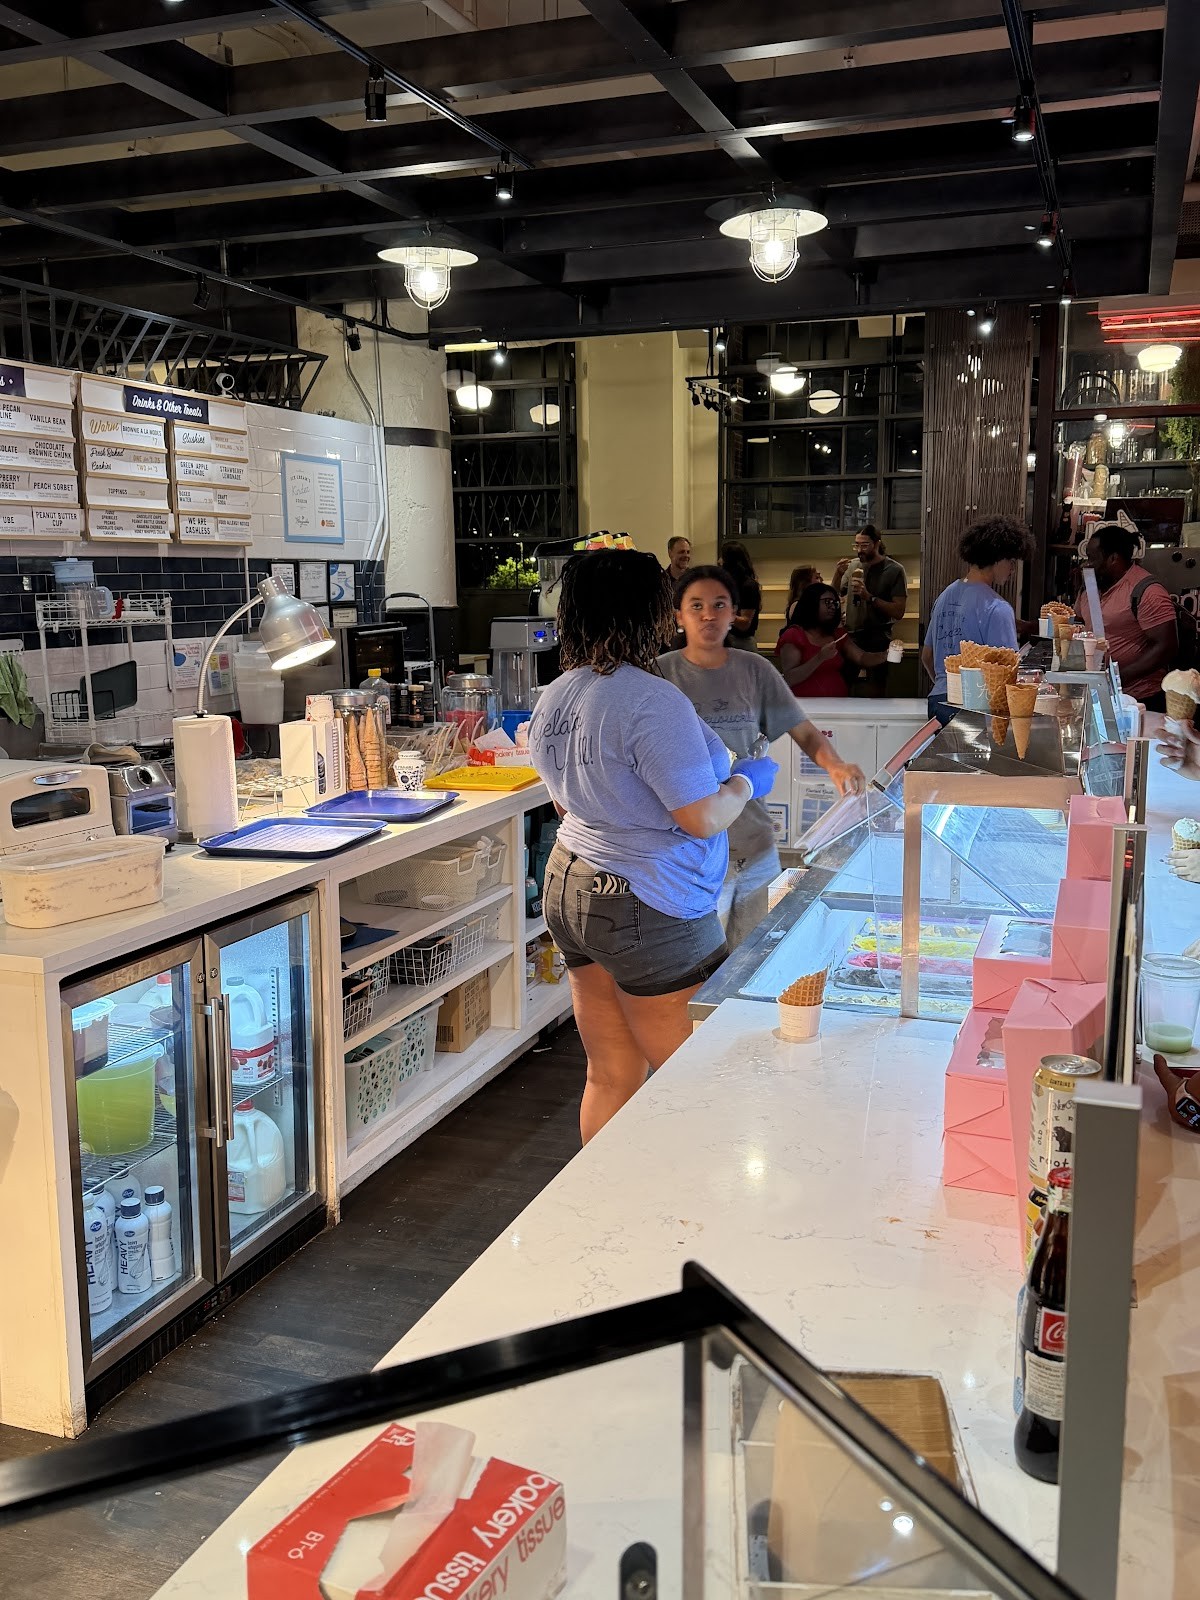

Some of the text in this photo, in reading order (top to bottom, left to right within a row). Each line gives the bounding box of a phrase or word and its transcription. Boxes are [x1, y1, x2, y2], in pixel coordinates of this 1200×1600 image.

[3, 403, 21, 413] PECAN
[132, 394, 203, 418] Drinks & Other Treats
[0, 411, 12, 420] LINE
[30, 414, 67, 426] VANILLA BEAN
[89, 419, 120, 434] Warm
[122, 425, 140, 434] BROWNIE
[0, 445, 18, 454] OLATE
[34, 441, 65, 451] CHOCOLATE
[28, 448, 72, 460] BROWNIE CHUNK
[90, 447, 106, 458] Fresh
[91, 461, 112, 471] Cookies
[180, 461, 209, 471] GREEN APPLE
[219, 465, 244, 474] STRAWBERRY
[183, 468, 205, 477] LEMONADE
[222, 473, 242, 481] LEMONADE
[33, 482, 74, 492] PEACH SORBET
[2, 516, 15, 524] UBE
[35, 511, 77, 520] PEANUT BUTTER
[52, 519, 63, 527] CUP
[187, 517, 207, 526] WE ARE
[185, 526, 211, 535] CASHLESS
[533, 708, 582, 753] Gelato
[1039, 1155, 1069, 1168] root
[120, 1240, 129, 1275] HEAVY
[516, 1496, 566, 1563] tissue
[413, 1473, 560, 1600] bakery tissu
[287, 1530, 325, 1559] BT-6
